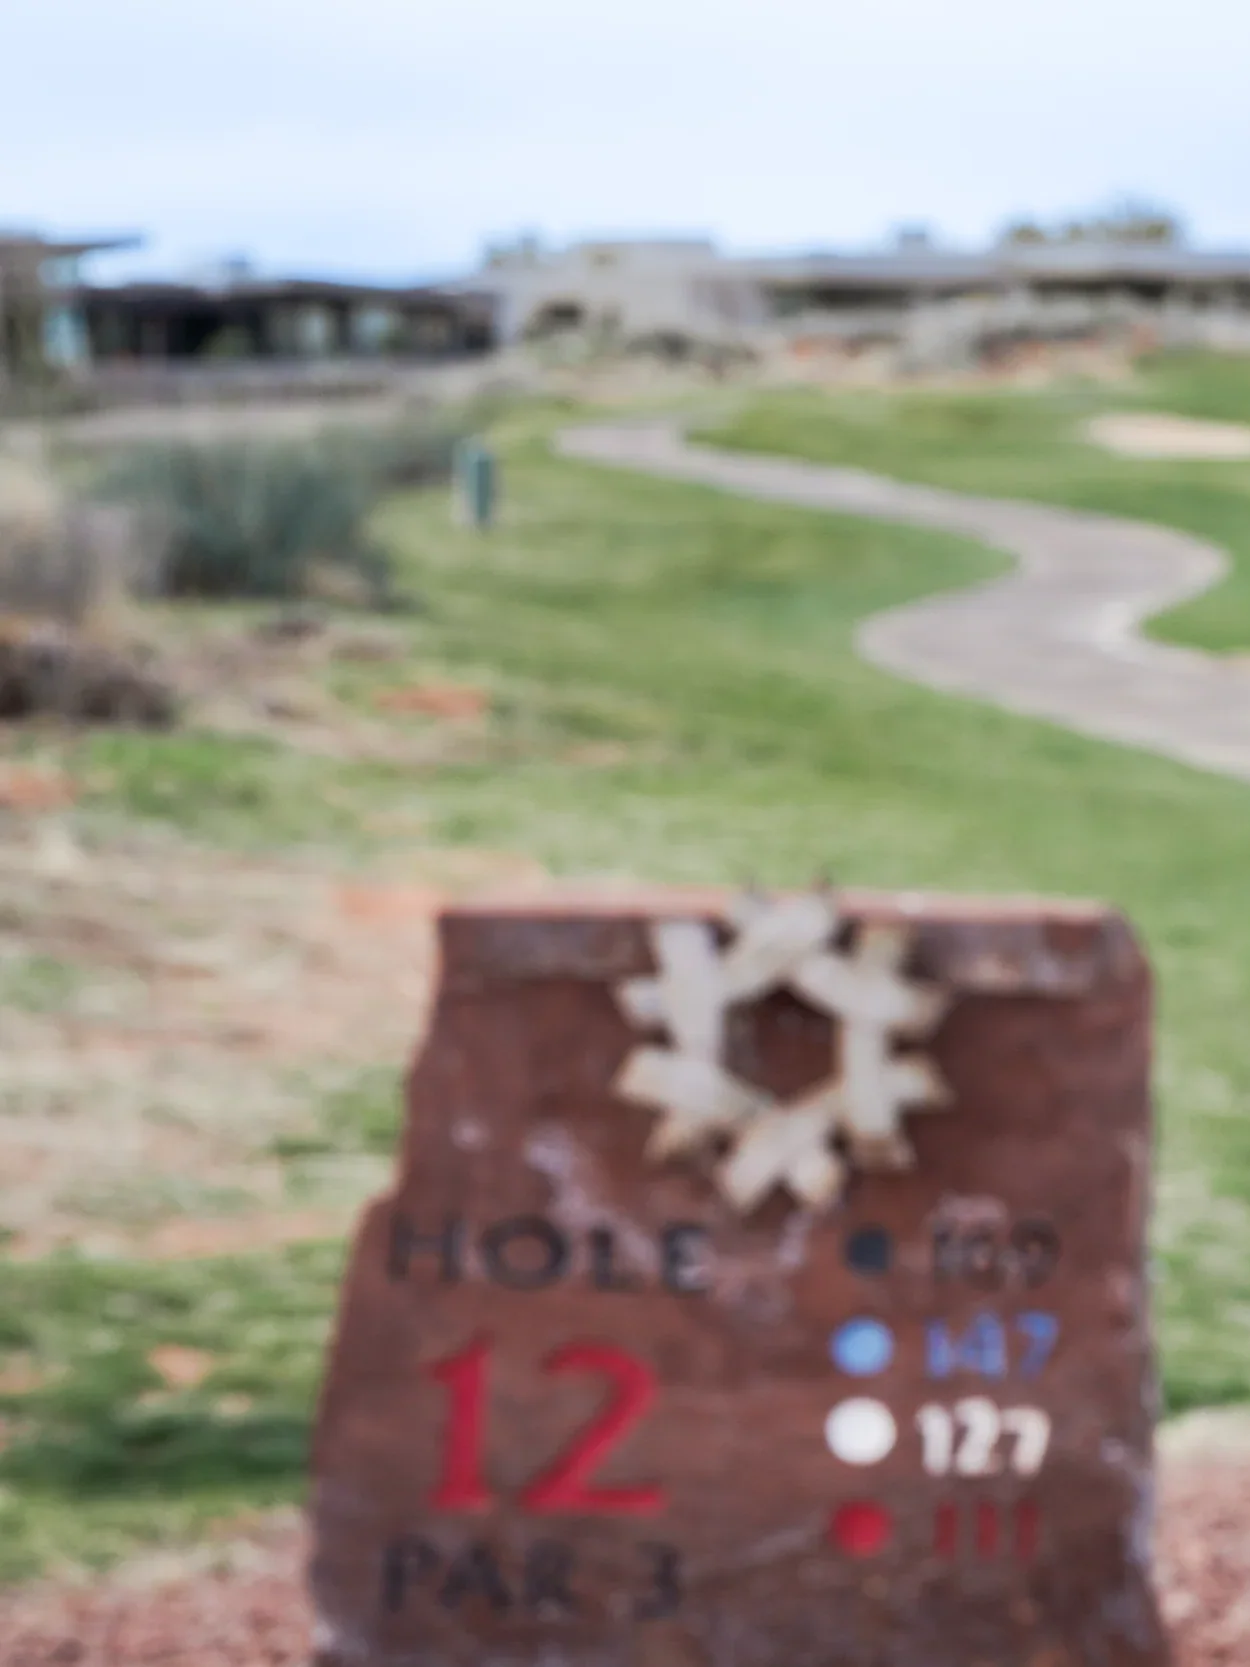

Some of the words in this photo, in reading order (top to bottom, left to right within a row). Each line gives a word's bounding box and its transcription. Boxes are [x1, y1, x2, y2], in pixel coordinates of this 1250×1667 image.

[386, 1212, 712, 1292] HOLE
[924, 1310, 1060, 1380] 147
[430, 1331, 668, 1515] 12
[916, 1397, 1052, 1477] 127
[932, 1503, 1042, 1560] 111
[380, 1538, 580, 1614] PAR
[632, 1539, 682, 1622] 3
